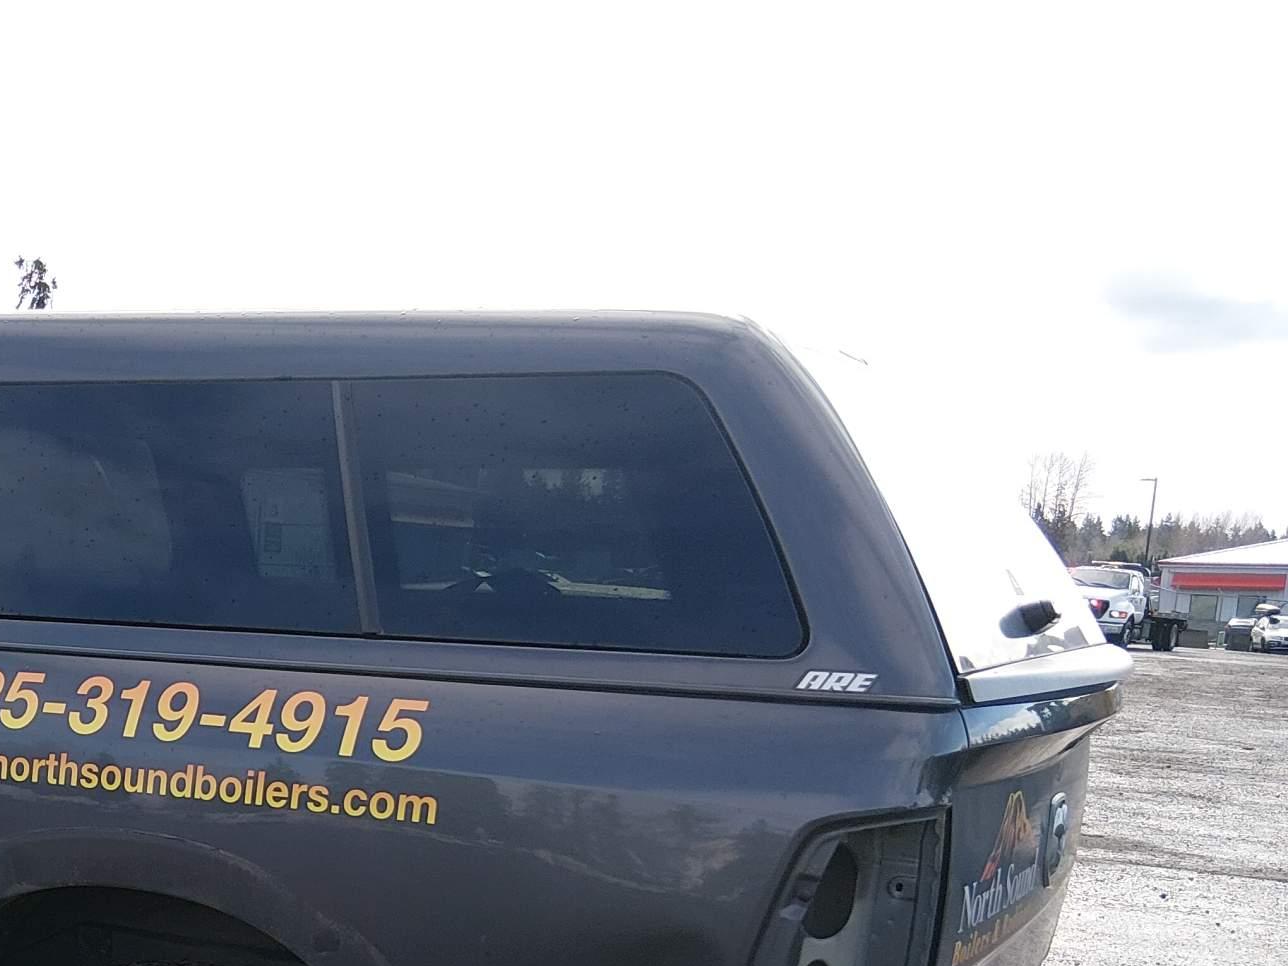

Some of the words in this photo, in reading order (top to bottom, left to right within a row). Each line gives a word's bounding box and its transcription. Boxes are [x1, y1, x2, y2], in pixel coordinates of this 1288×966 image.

[795, 670, 879, 692] ARE
[957, 867, 1003, 933] North
[1003, 847, 1039, 909] Sound
